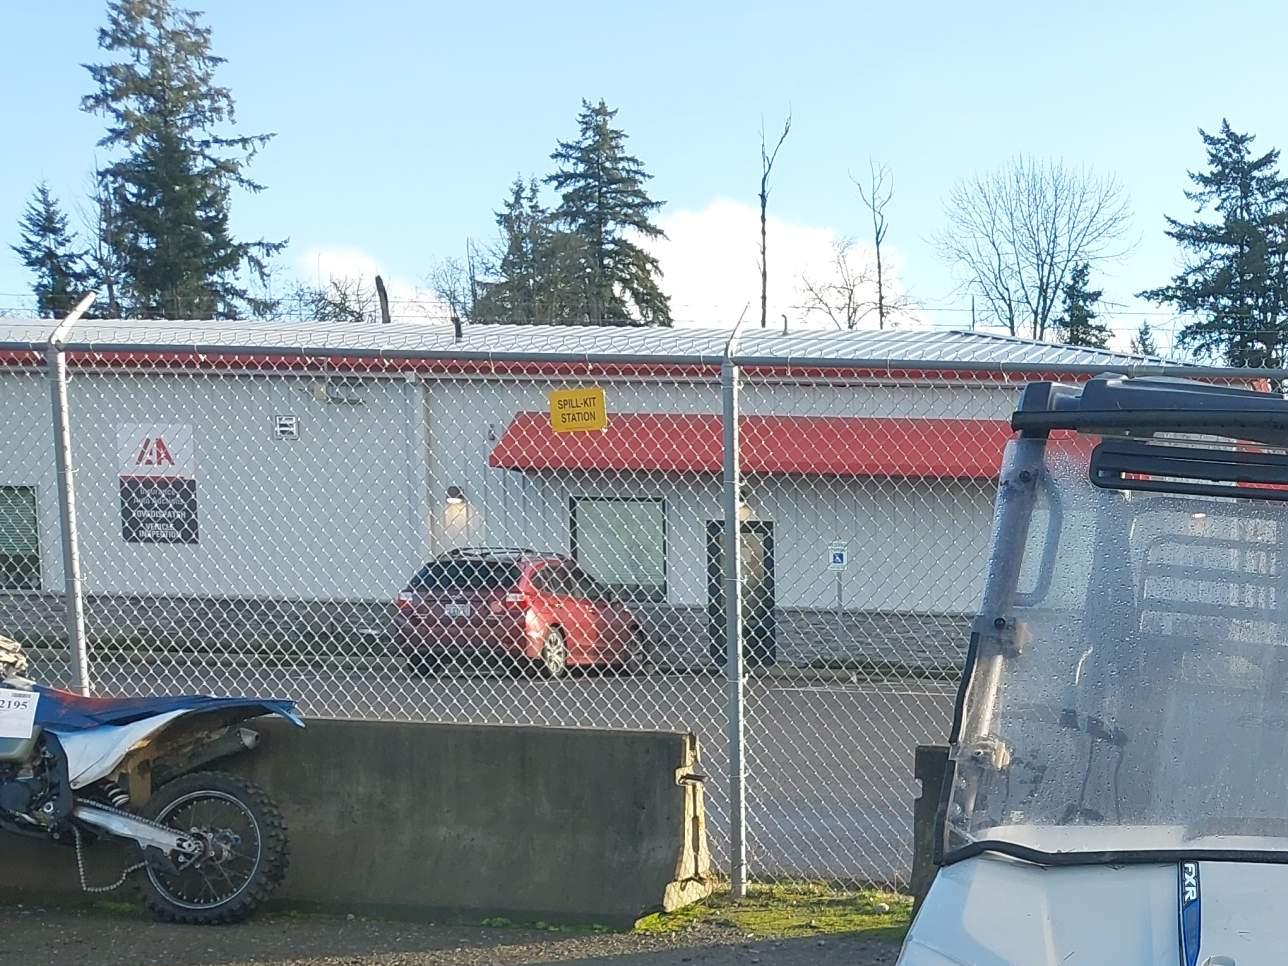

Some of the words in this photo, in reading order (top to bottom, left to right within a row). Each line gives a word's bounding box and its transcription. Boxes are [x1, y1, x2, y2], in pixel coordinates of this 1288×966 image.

[557, 396, 596, 409] SPILL-KIT
[560, 411, 596, 423] STATION
[1184, 863, 1198, 903] FXR
